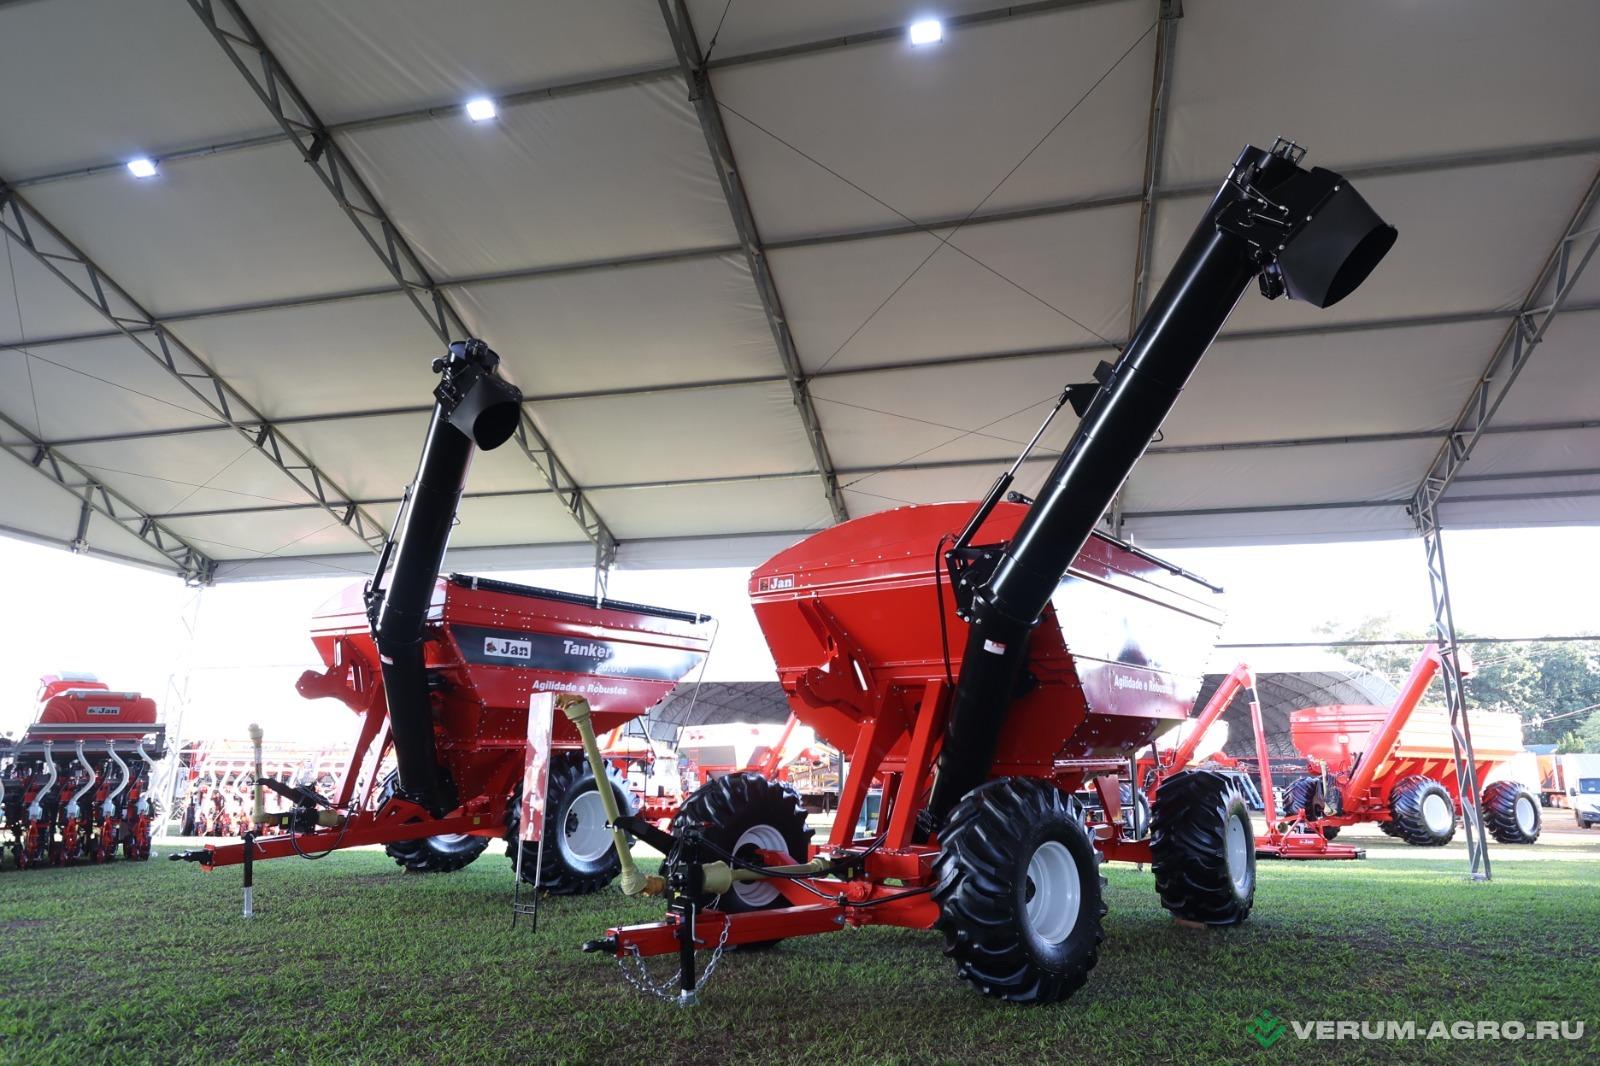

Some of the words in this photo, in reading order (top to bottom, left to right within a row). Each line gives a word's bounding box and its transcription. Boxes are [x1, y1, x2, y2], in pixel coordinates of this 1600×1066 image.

[770, 577, 792, 589] Jan
[501, 642, 528, 657] Jan
[563, 640, 613, 658] Tanker
[532, 680, 578, 692] Agilidade
[579, 685, 586, 693] e
[587, 683, 628, 695] Robustez
